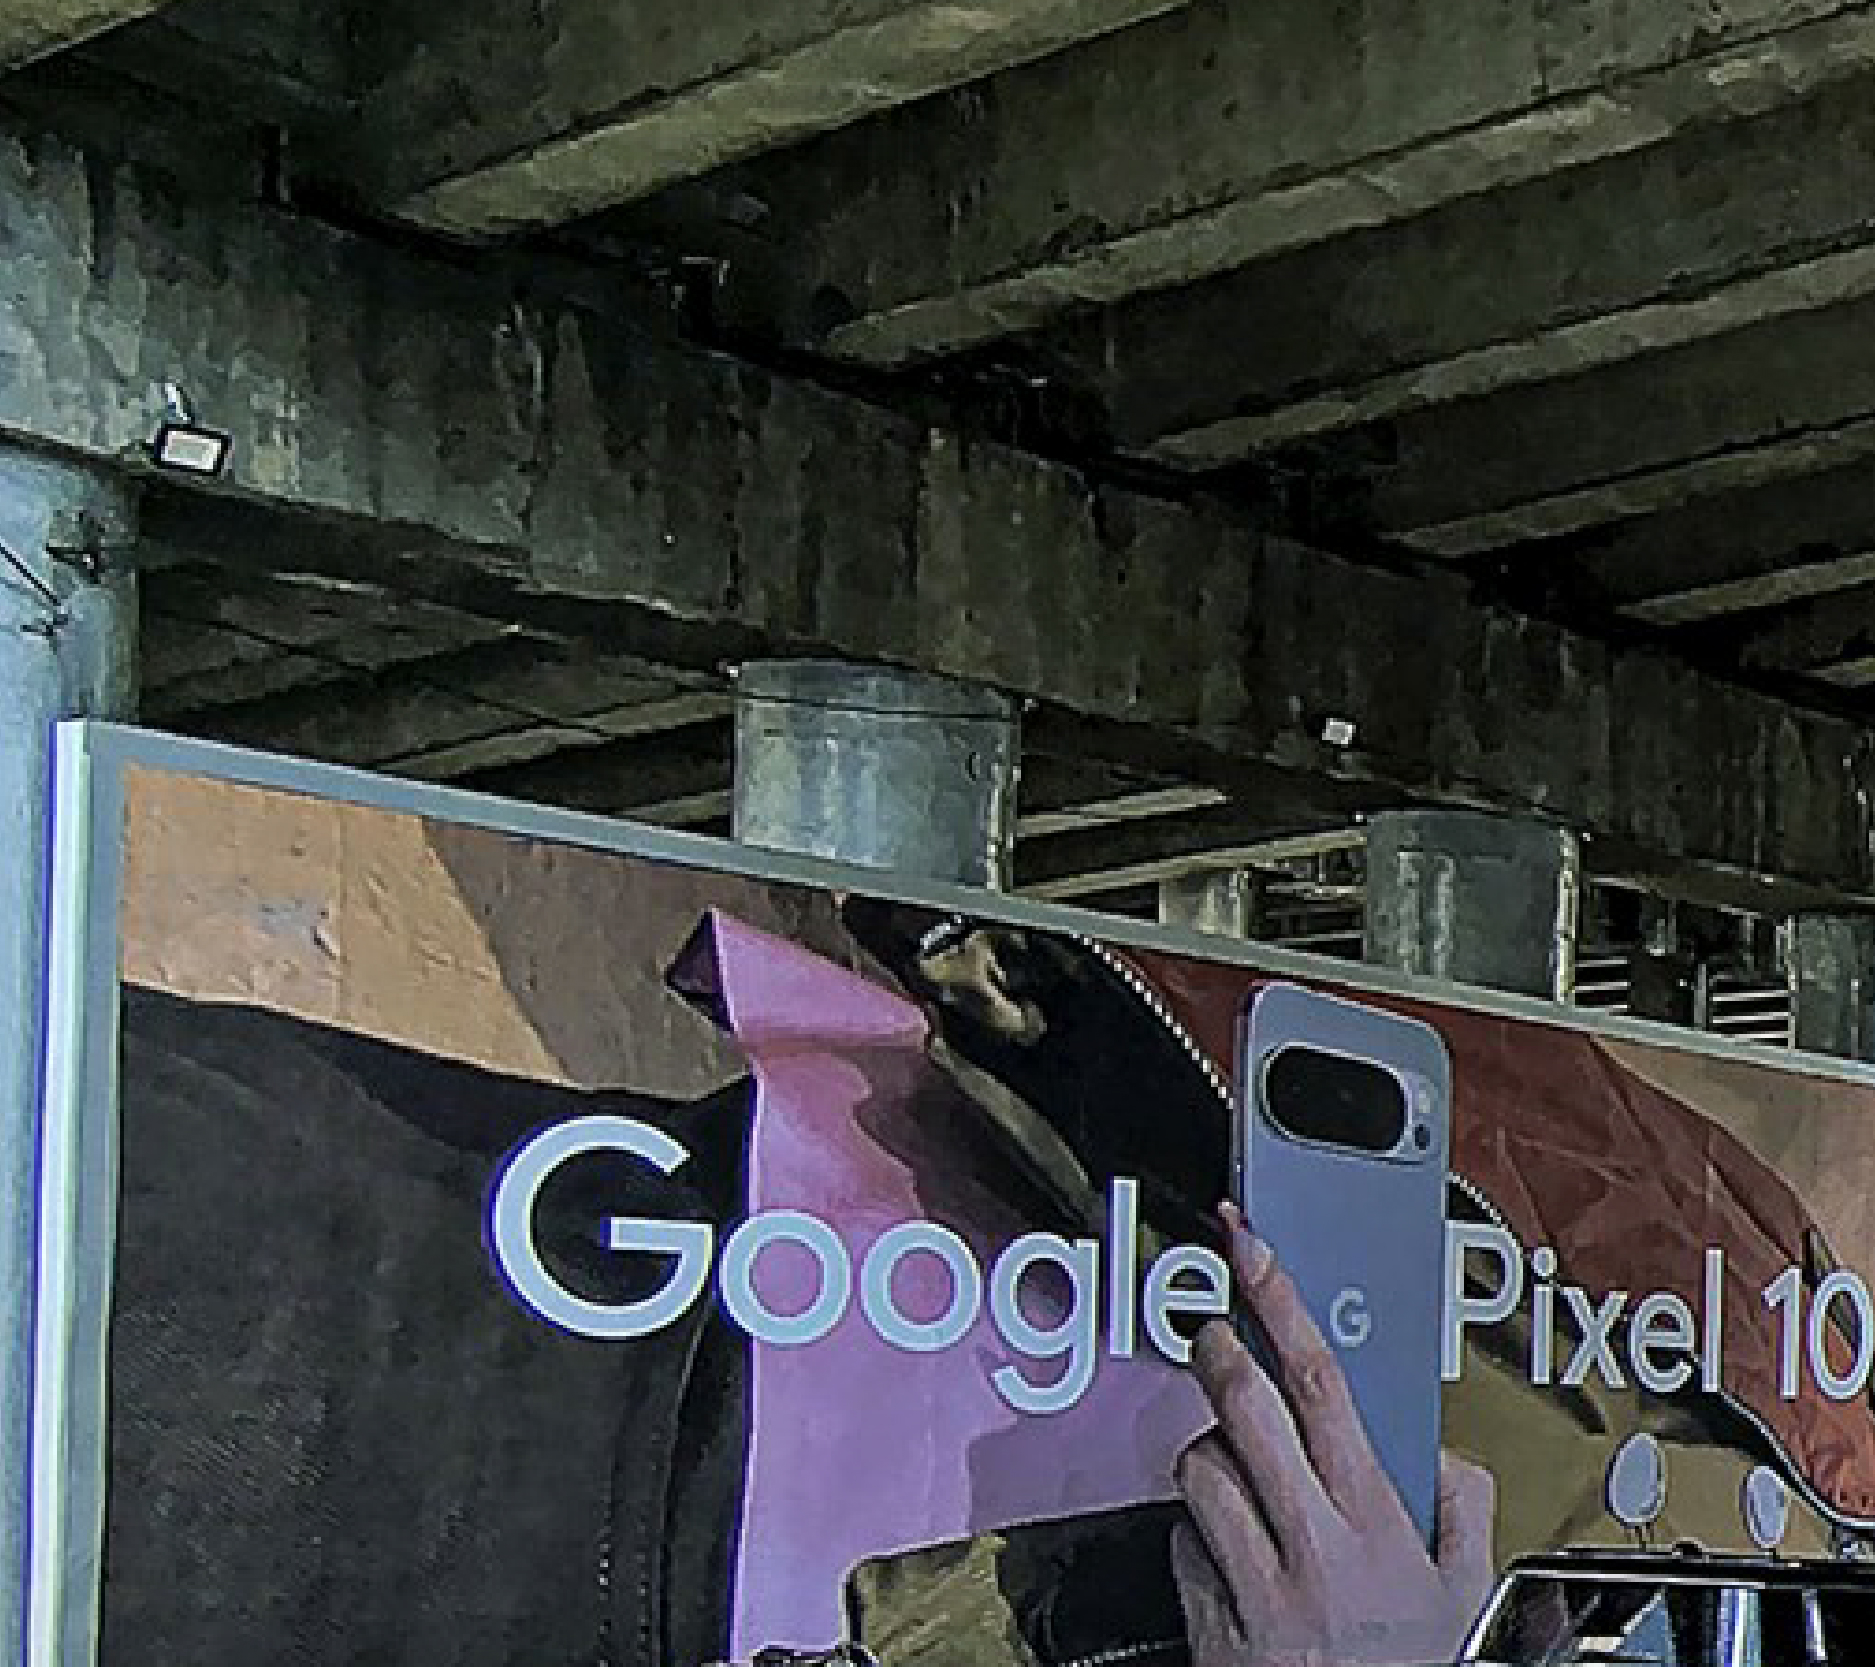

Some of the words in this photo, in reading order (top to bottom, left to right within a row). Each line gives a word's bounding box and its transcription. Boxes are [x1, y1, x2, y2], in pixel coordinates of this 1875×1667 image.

[492, 1114, 1231, 1414] Google
[1440, 1220, 1725, 1393] Pixel
[1761, 1265, 1875, 1400] 10
